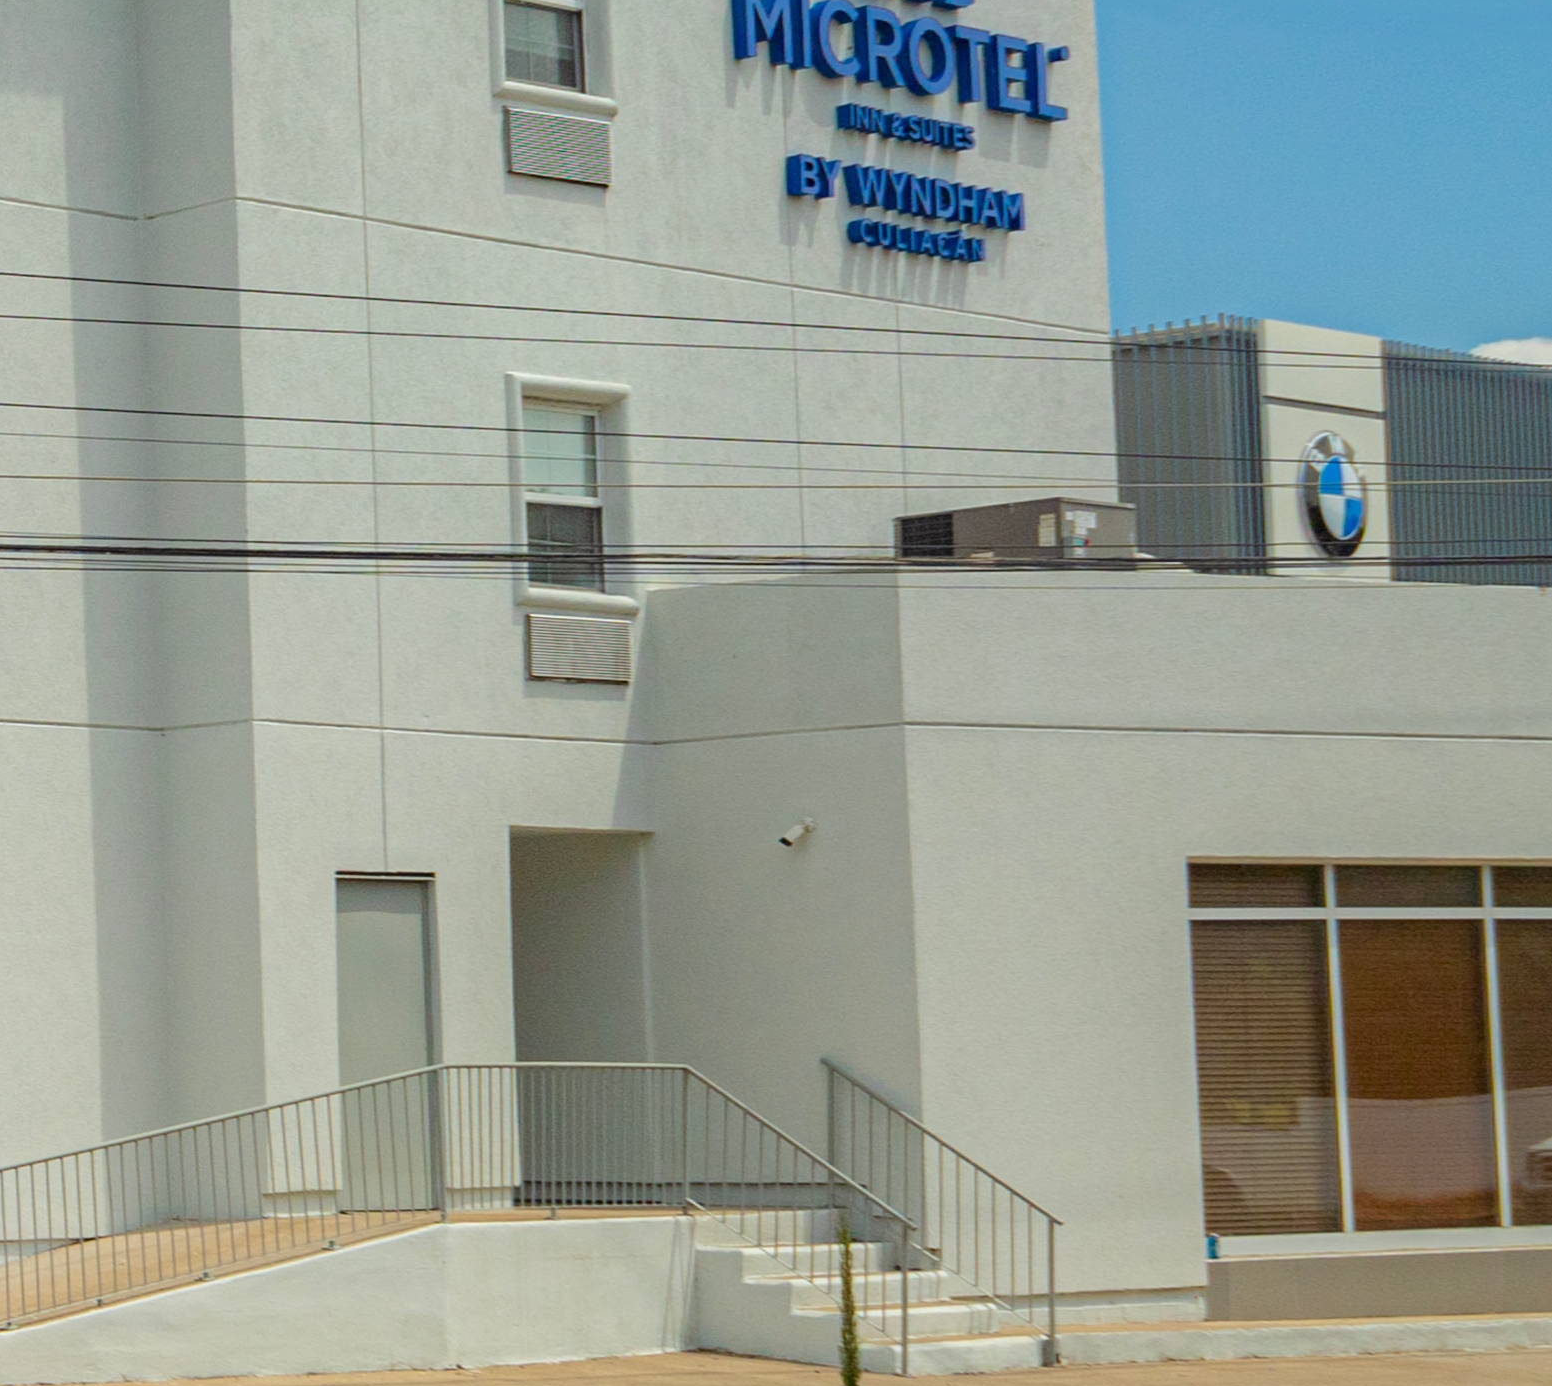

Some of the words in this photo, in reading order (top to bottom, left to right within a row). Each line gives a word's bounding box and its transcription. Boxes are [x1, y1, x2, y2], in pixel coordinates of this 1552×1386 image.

[839, 103, 887, 135] INN
[891, 113, 907, 140] &
[906, 115, 976, 151] SUITES
[787, 154, 842, 199] BY
[847, 164, 1026, 231] WYNDHAM
